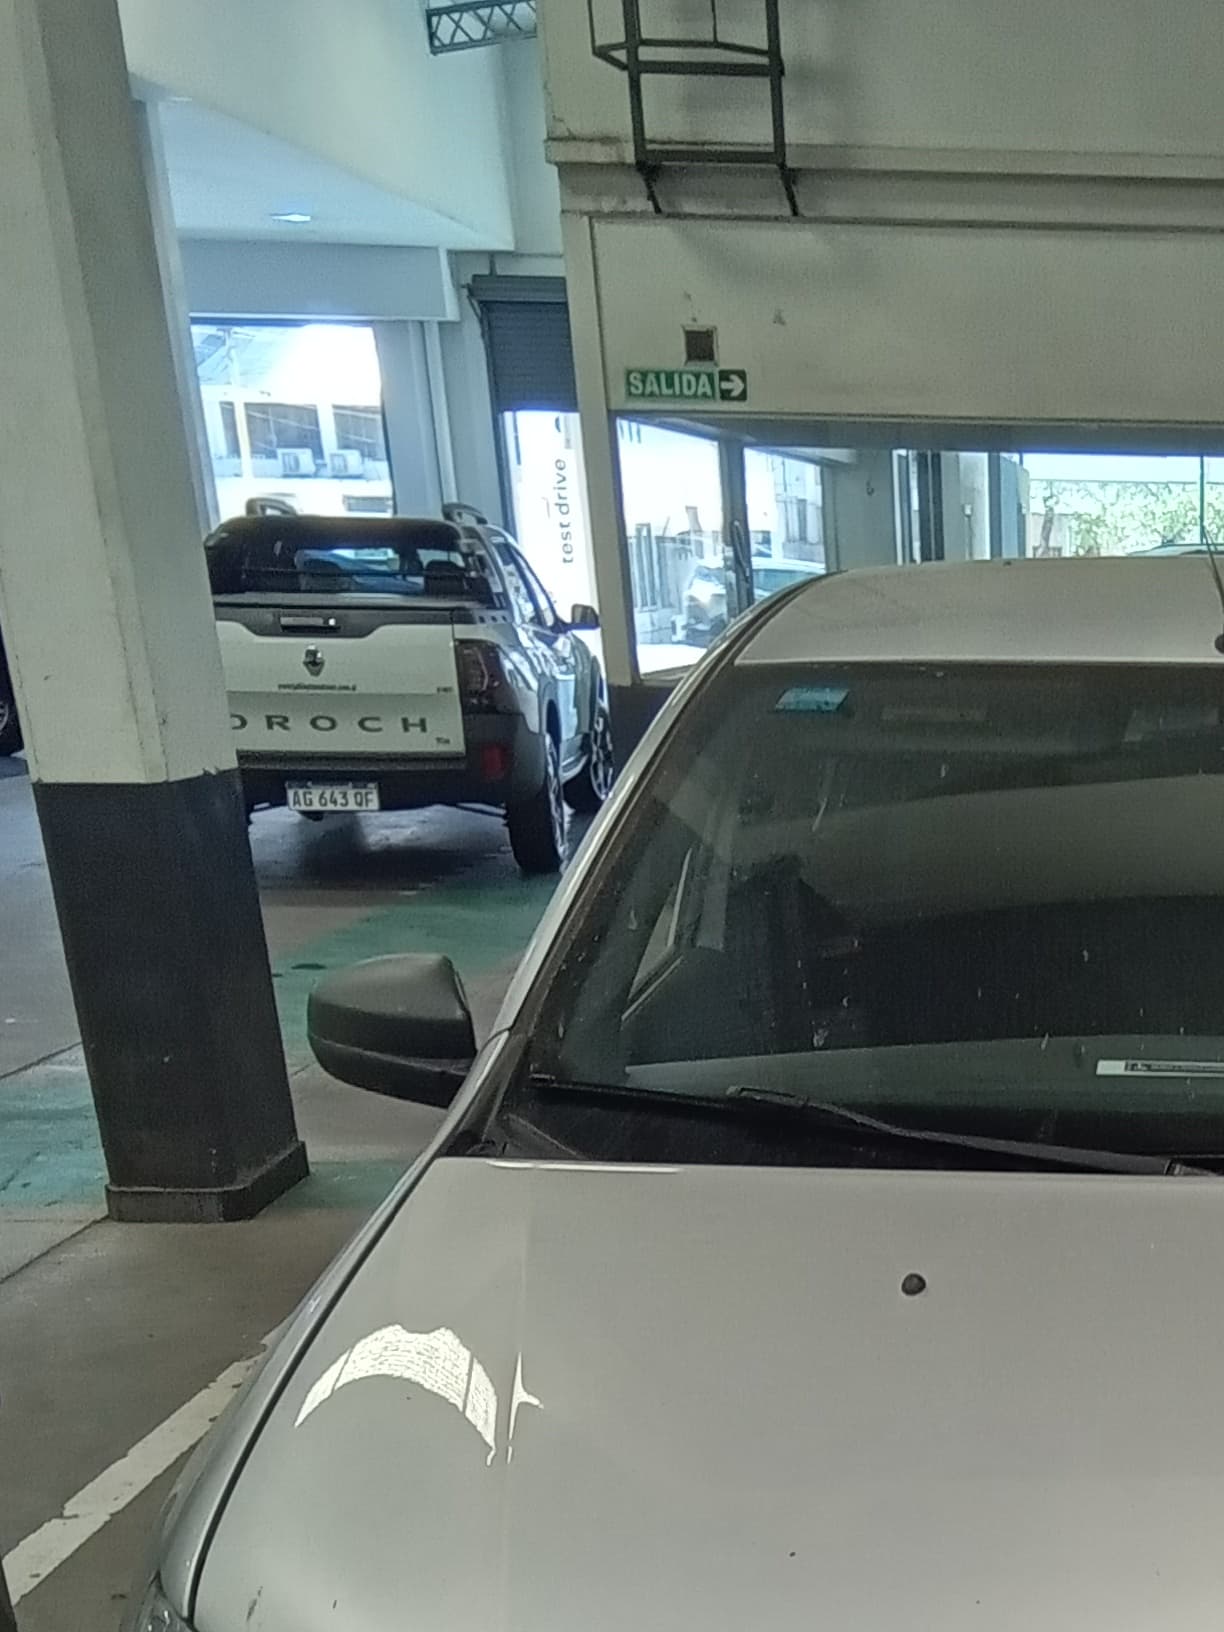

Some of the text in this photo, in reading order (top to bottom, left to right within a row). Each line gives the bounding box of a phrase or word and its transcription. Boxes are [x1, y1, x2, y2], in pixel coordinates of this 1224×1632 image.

[628, 371, 713, 397] SALIDA
[553, 458, 574, 564] test drive
[292, 790, 313, 807] AG
[318, 790, 349, 807] 643
